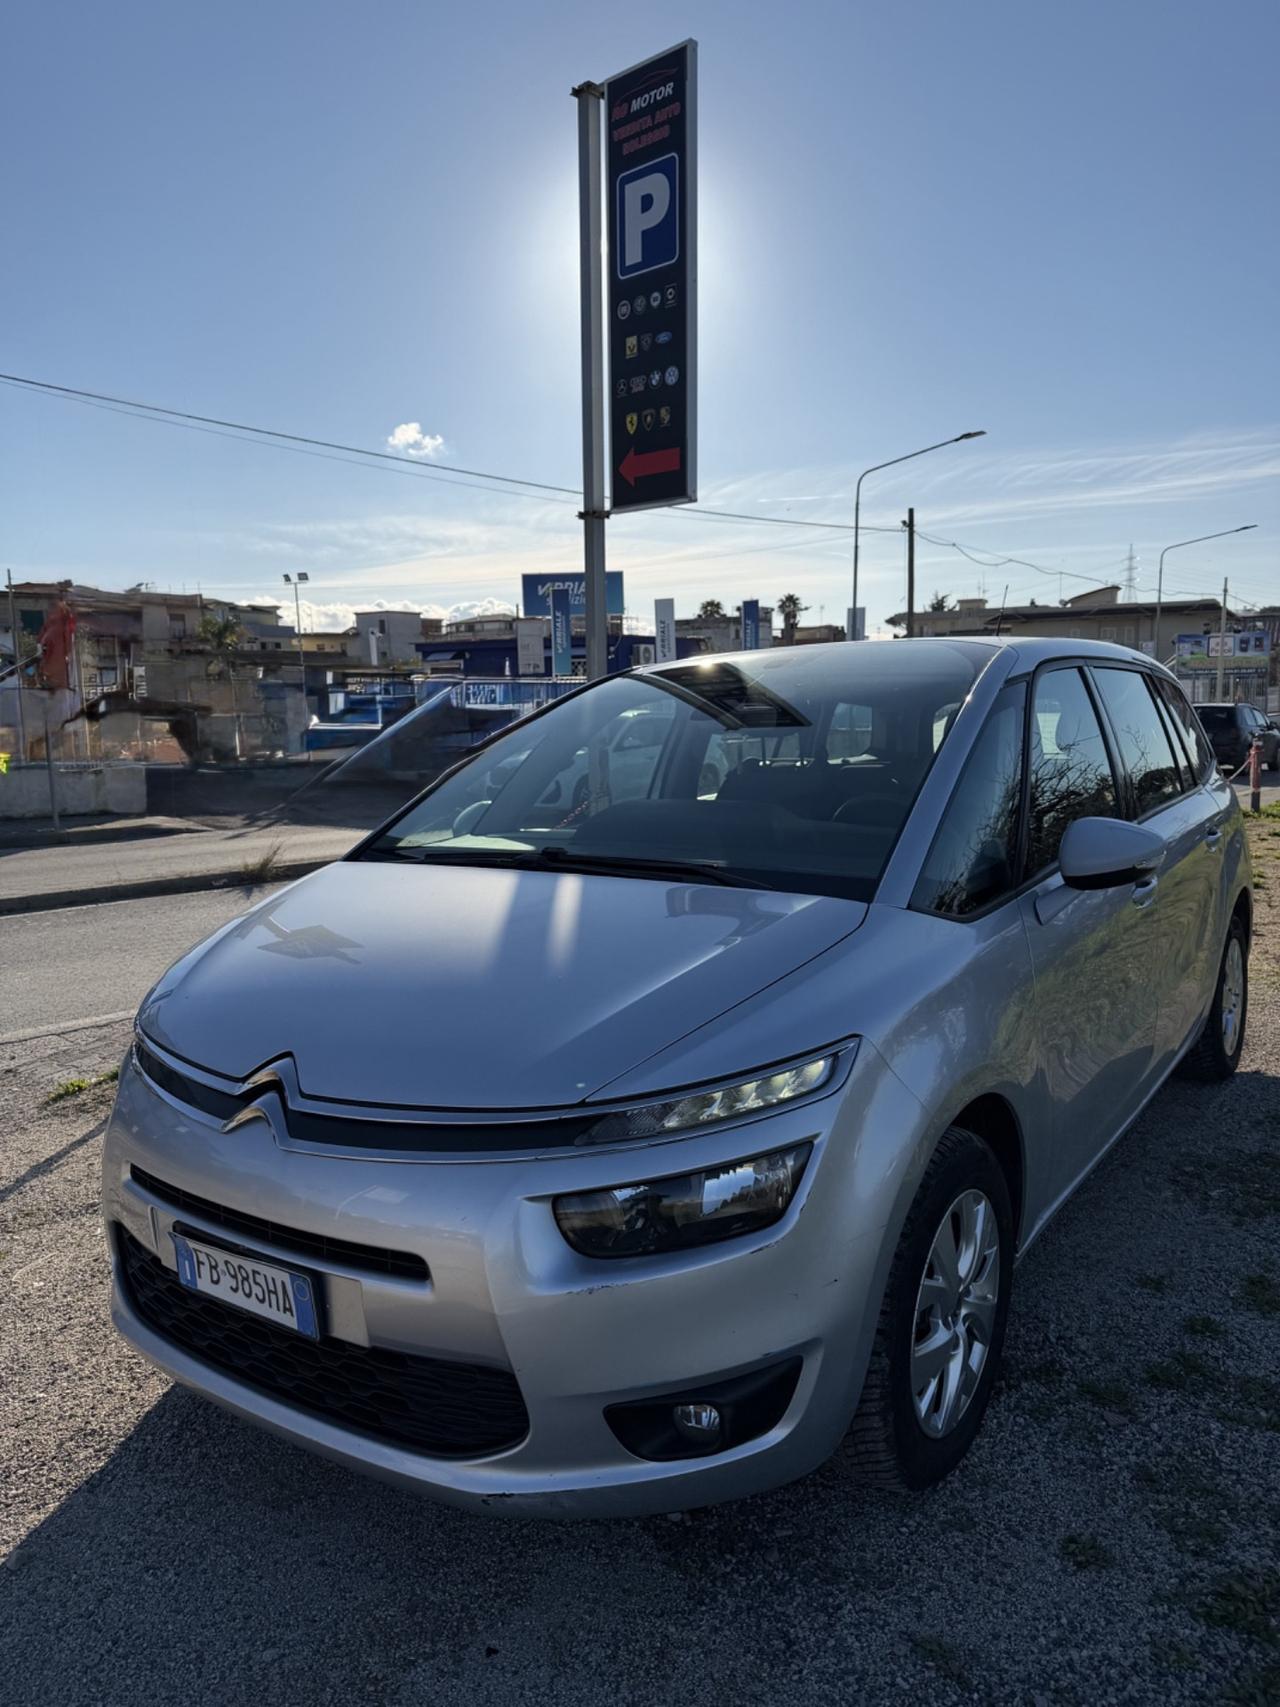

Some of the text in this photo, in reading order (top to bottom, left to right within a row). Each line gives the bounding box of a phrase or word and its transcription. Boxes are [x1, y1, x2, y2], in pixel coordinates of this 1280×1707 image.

[630, 82, 674, 113] MOTOR
[624, 172, 670, 267] P
[192, 1247, 221, 1286] FB
[224, 1259, 295, 1318] 985HA
